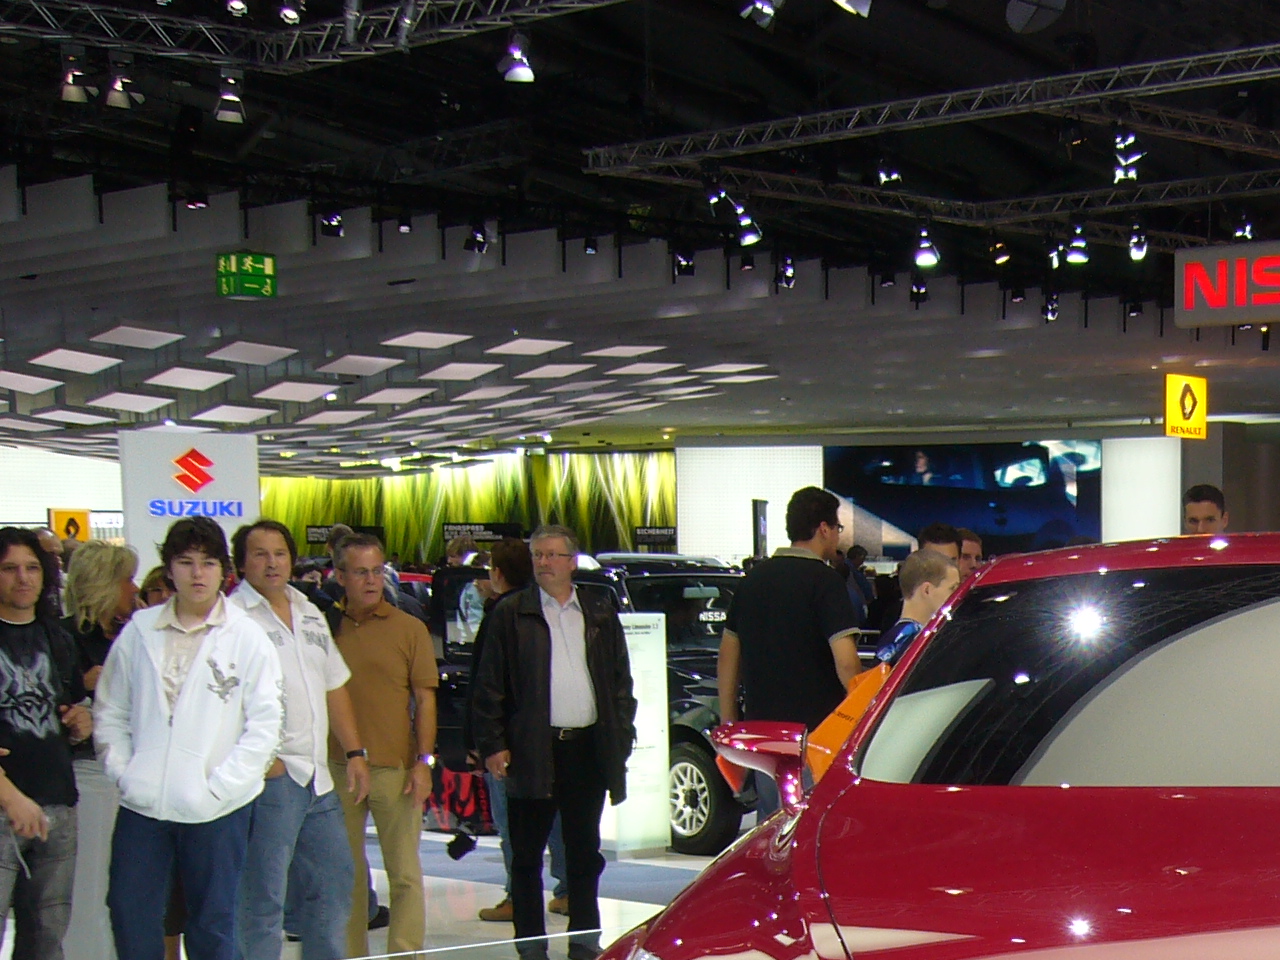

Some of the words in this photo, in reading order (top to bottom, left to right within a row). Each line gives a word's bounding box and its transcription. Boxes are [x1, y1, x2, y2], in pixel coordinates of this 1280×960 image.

[1170, 425, 1202, 435] RENAULT
[149, 500, 243, 517] SUZUKI
[699, 612, 727, 621] NISSA
